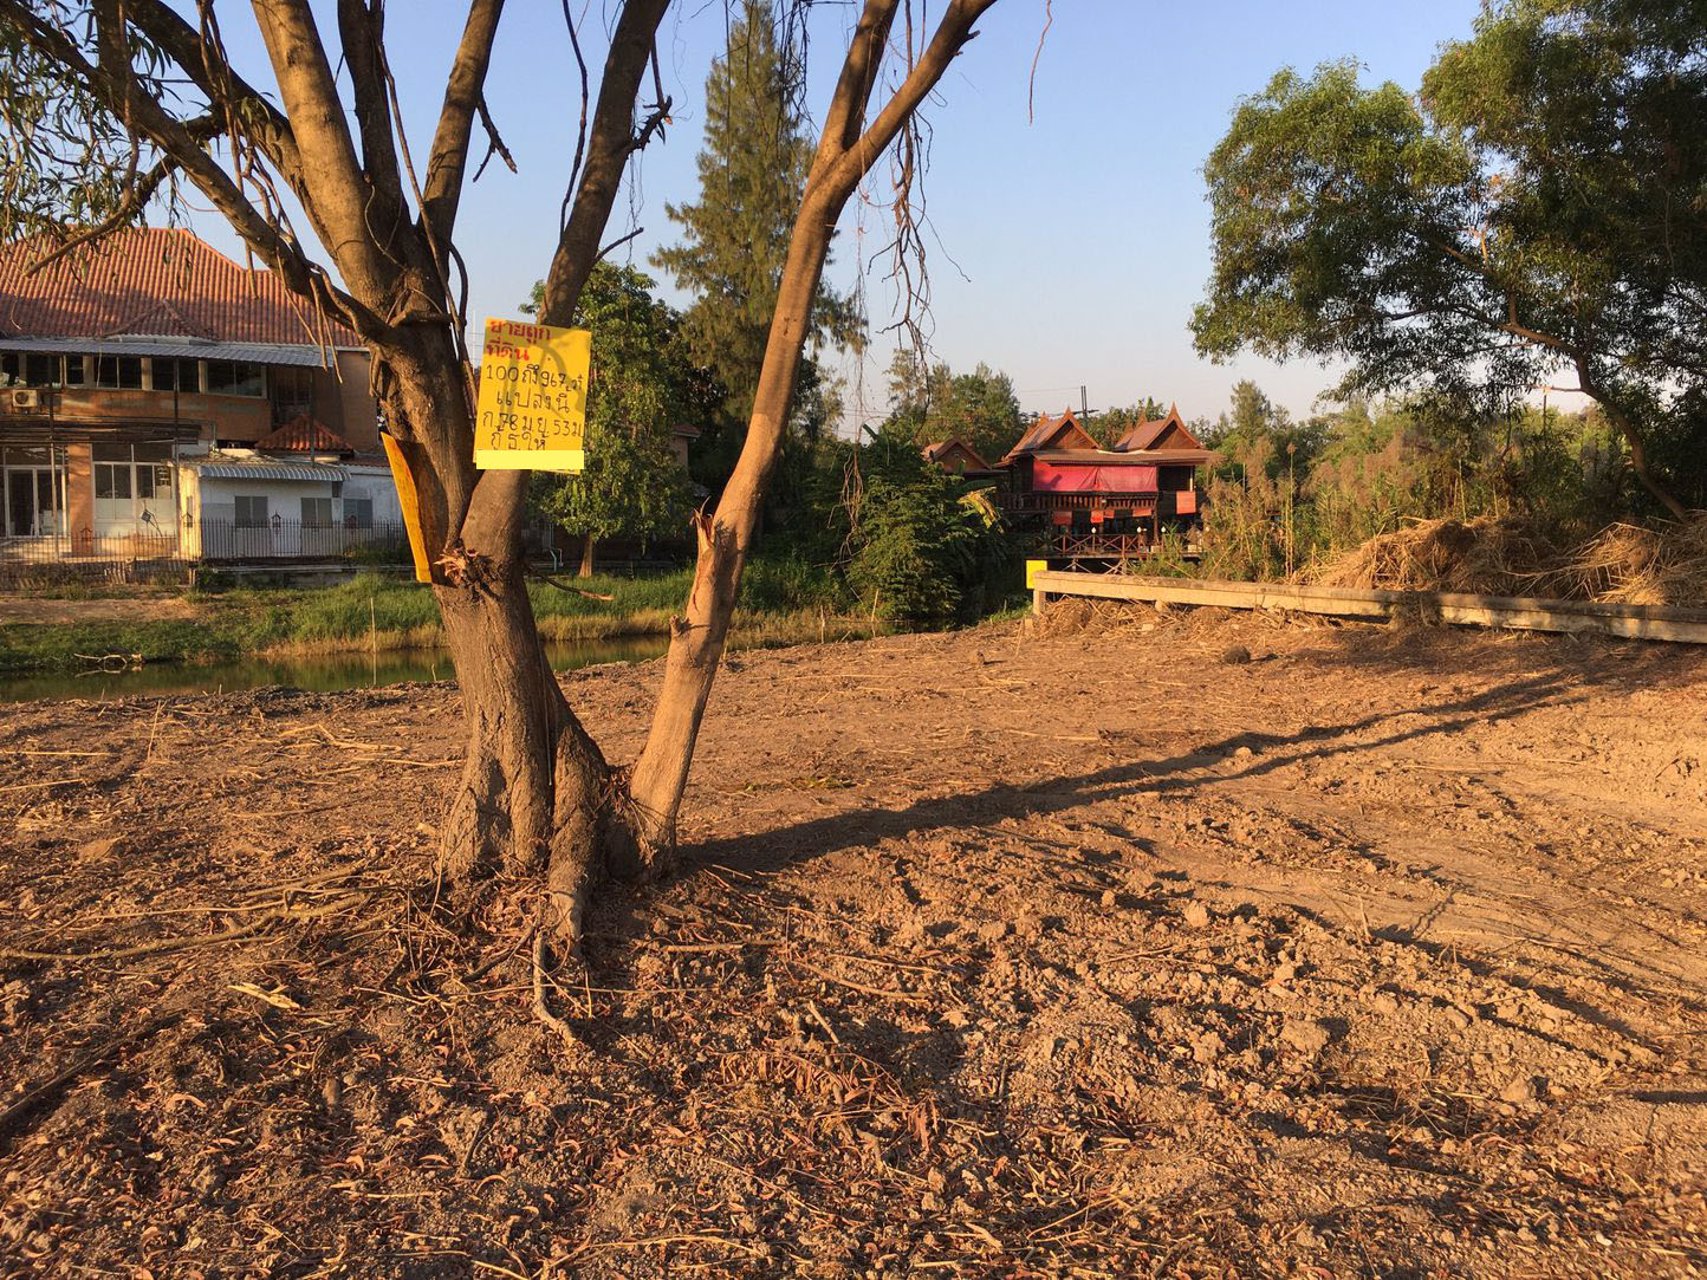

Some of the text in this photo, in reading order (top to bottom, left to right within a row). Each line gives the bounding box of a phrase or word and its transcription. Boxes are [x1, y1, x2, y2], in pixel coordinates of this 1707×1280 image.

[491, 320, 552, 344] ขายถูก
[486, 337, 530, 361] ที่ดิน
